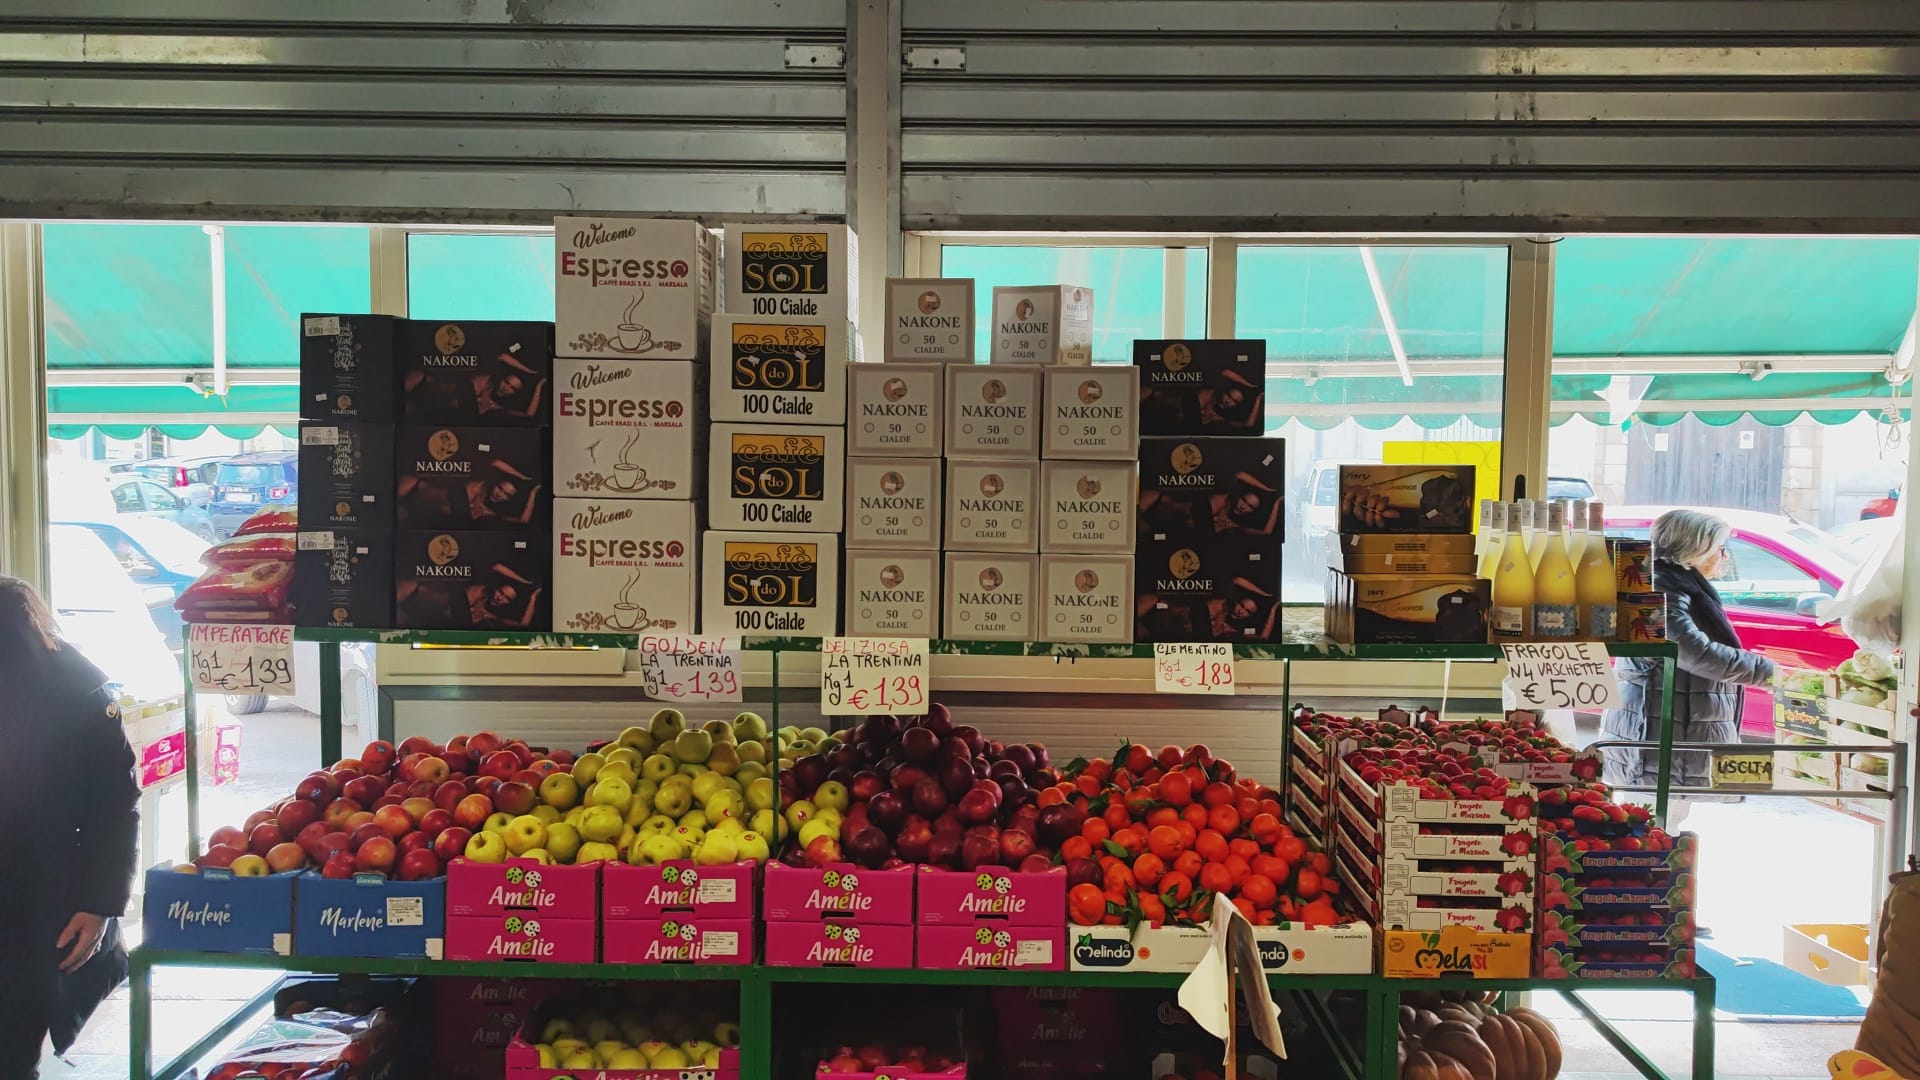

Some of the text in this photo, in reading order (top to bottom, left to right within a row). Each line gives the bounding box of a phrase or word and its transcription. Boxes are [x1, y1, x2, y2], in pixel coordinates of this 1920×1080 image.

[573, 223, 636, 249] Welcome
[562, 252, 688, 287] Espresso
[745, 263, 825, 292] SOL
[753, 297, 817, 316] 100 Cialde
[898, 316, 961, 328] NAKONE
[1001, 322, 1049, 334] NAKONE
[923, 335, 936, 345] 50
[1018, 340, 1029, 349] 50
[914, 346, 944, 354] CIALDE
[1012, 351, 1035, 359] CIALDE
[423, 355, 478, 367] NAKONE
[570, 364, 632, 390] Welcome
[735, 355, 822, 389] SOL
[768, 367, 785, 380] do
[1151, 371, 1203, 382] NAKONE
[559, 392, 683, 427] Espresso
[743, 394, 813, 415] 100 Cialde
[863, 404, 927, 417] NAKONE
[961, 405, 1026, 418] NAKONE
[1057, 406, 1123, 419] NAKONE
[888, 423, 901, 434] 50
[986, 425, 1000, 435] 50
[1083, 426, 1096, 435] 50
[880, 435, 911, 443] CIALDE
[977, 437, 1009, 445] CIALDE
[1074, 438, 1106, 446] CIALDE
[416, 461, 471, 473] NAKONE
[735, 467, 821, 498] SOL
[768, 475, 784, 488] do
[1158, 474, 1215, 486] NAKONE
[860, 497, 925, 509] NAKONE
[960, 500, 1024, 512] NAKONE
[1056, 501, 1121, 514] NAKONE
[572, 505, 633, 530] Welcome
[742, 503, 812, 523] 100 Cialde
[885, 516, 898, 526] 50
[985, 519, 998, 528] 50
[1082, 521, 1095, 530] 50
[876, 528, 908, 536] CIALDE
[976, 530, 1007, 538] CIALDE
[1073, 532, 1104, 540] CIALDE
[560, 533, 684, 567] Espresso
[416, 565, 471, 577] NAKONE
[728, 574, 814, 605] SOL
[760, 583, 777, 595] do
[1157, 579, 1213, 591] NAKONE
[860, 590, 925, 603] NAKONE
[959, 593, 1023, 605] NAKONE
[735, 610, 805, 631] 100 Cialde
[885, 609, 898, 619] 50
[984, 612, 997, 621] 50
[1080, 614, 1092, 624] 50
[876, 621, 908, 629] CIALDE
[975, 623, 1006, 631] CIALDE
[190, 625, 291, 645] IMPERATORE
[642, 636, 726, 655] GOLDEN
[825, 640, 909, 655] DELIZIOSA
[1157, 644, 1226, 656] CLEMENTINO
[1503, 643, 1591, 662] FRAGOLE
[640, 654, 731, 668] LA TRENTINA
[828, 654, 921, 668] LA TRENTINA
[1537, 662, 1605, 676] VASCHETTE
[488, 886, 556, 907] Amélie
[804, 889, 872, 910] Amélie
[959, 891, 1025, 913] Amélie
[168, 900, 231, 930] Marlene
[320, 908, 384, 937] Marlene
[487, 935, 554, 957] Amélie
[806, 941, 873, 962] Amélie
[1076, 943, 1131, 959] Melinda
